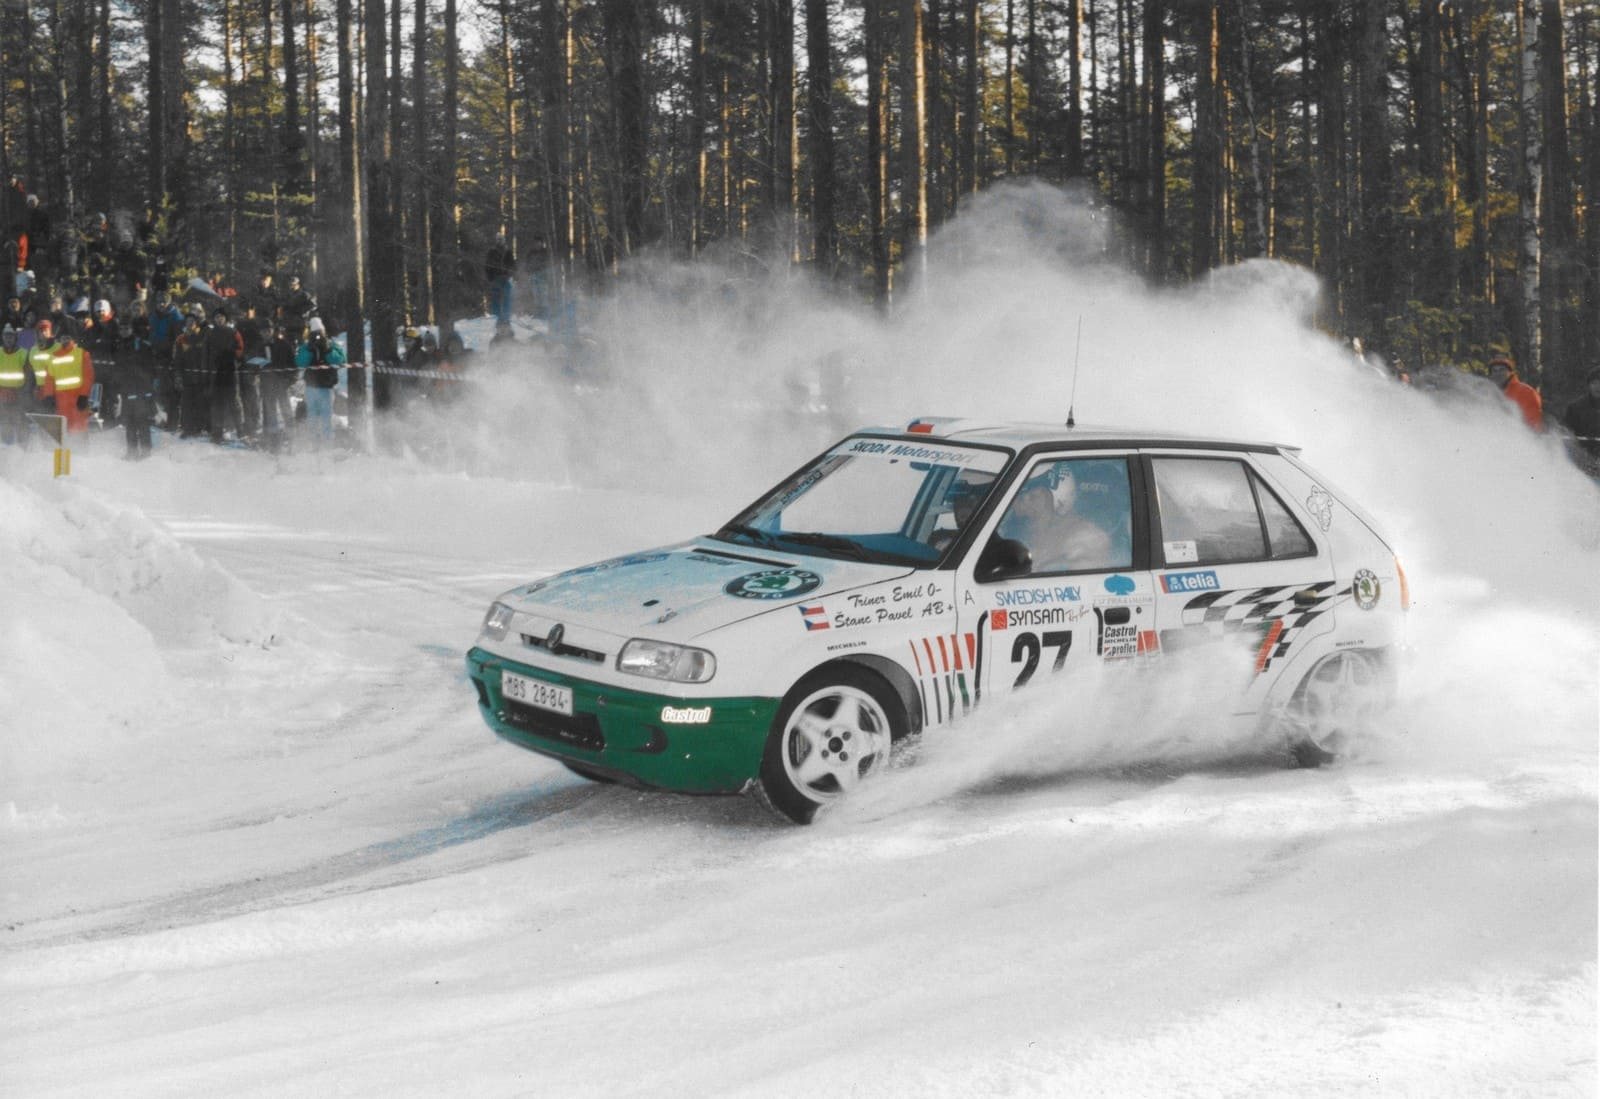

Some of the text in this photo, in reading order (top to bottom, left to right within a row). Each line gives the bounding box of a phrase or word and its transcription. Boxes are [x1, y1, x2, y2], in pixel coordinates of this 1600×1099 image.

[888, 445, 975, 463] Motorsport
[1181, 573, 1217, 589] telia
[847, 593, 886, 608] Triner
[892, 585, 923, 602] Emil
[964, 589, 976, 606] A
[994, 587, 1054, 606] SWEDISH
[876, 606, 913, 623] Pavel
[1009, 608, 1065, 626] SYNSAM
[1104, 625, 1138, 638] Castrol
[827, 640, 868, 652] MICHELIN
[1011, 630, 1073, 690] 27
[505, 676, 527, 699] MBS
[661, 706, 711, 723] Castrol
